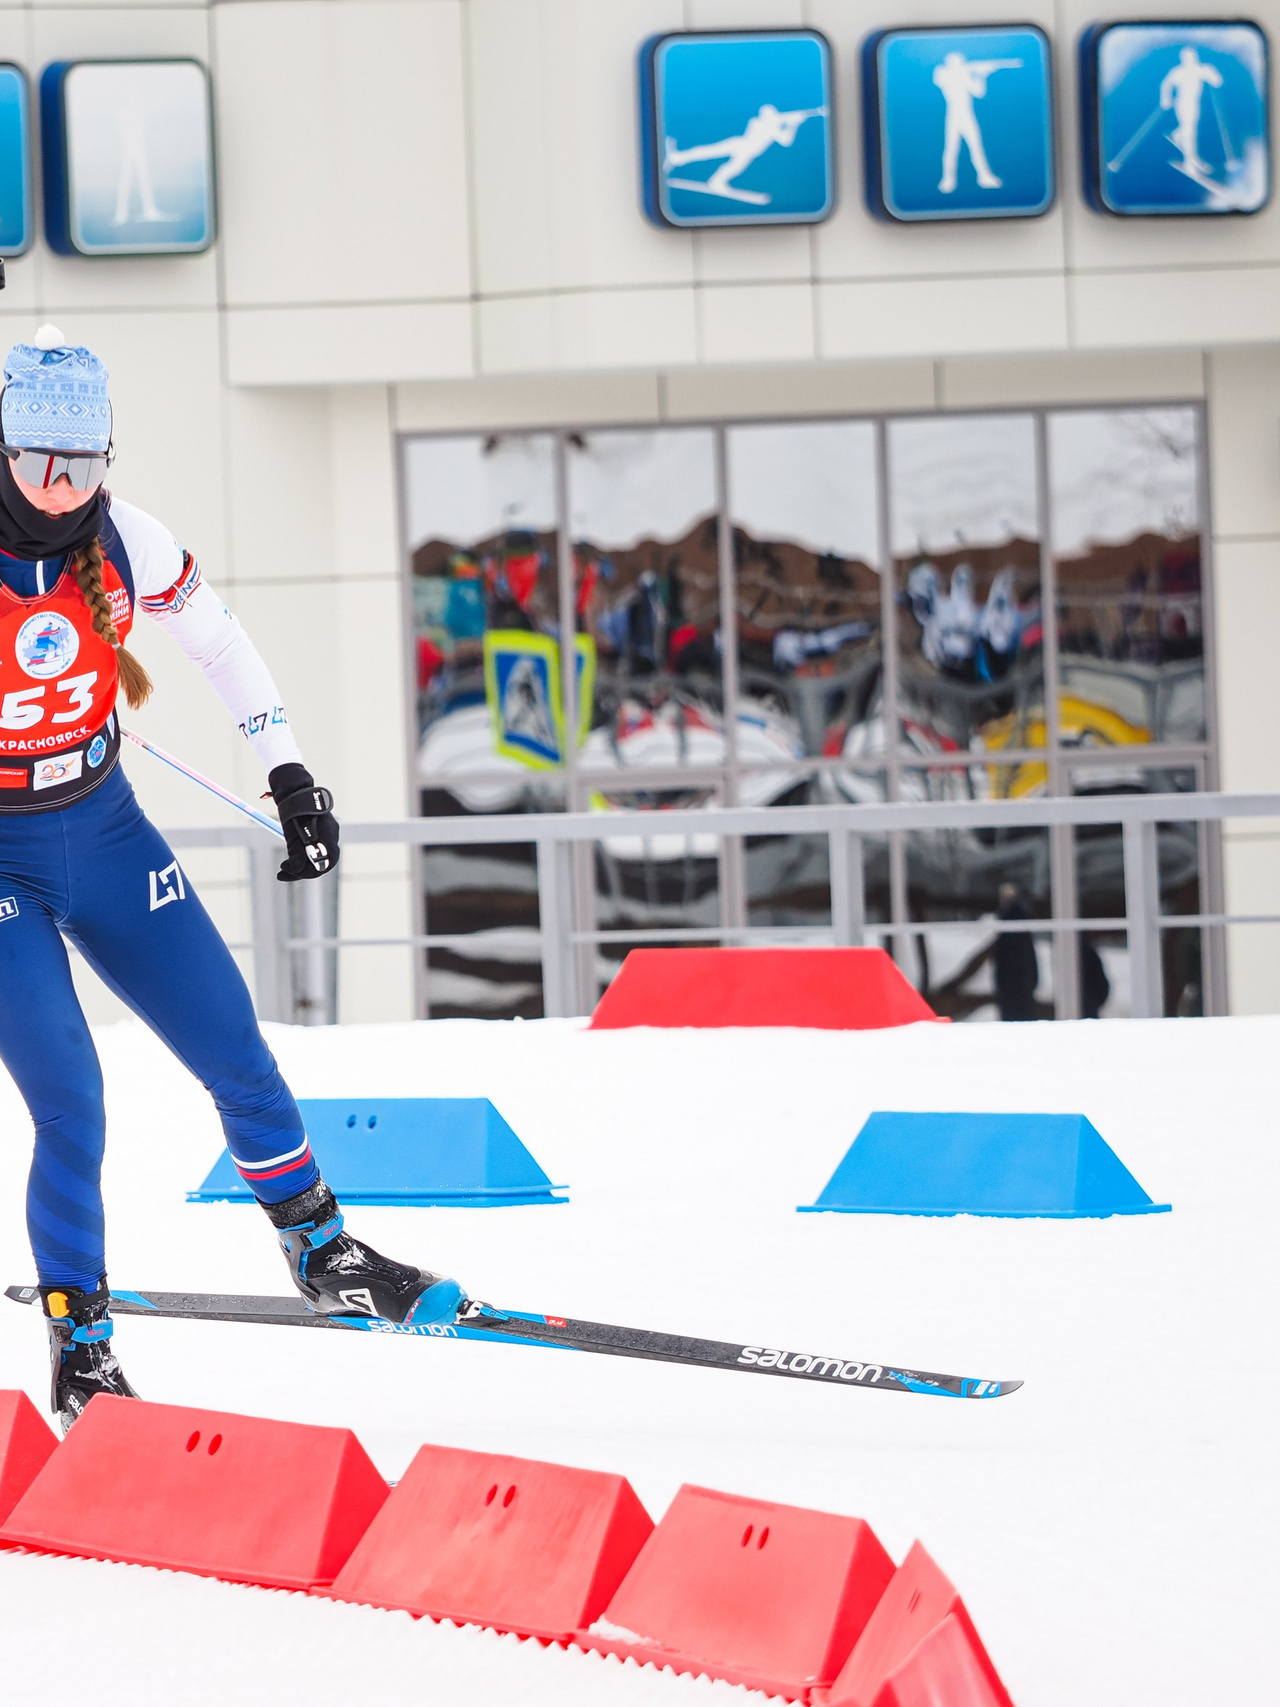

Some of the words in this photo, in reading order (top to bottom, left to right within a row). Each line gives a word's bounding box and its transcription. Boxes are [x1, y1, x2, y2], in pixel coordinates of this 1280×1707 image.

[367, 1320, 458, 1337] salomon
[736, 1346, 883, 1383] salomon
[68, 1394, 84, 1415] salo
